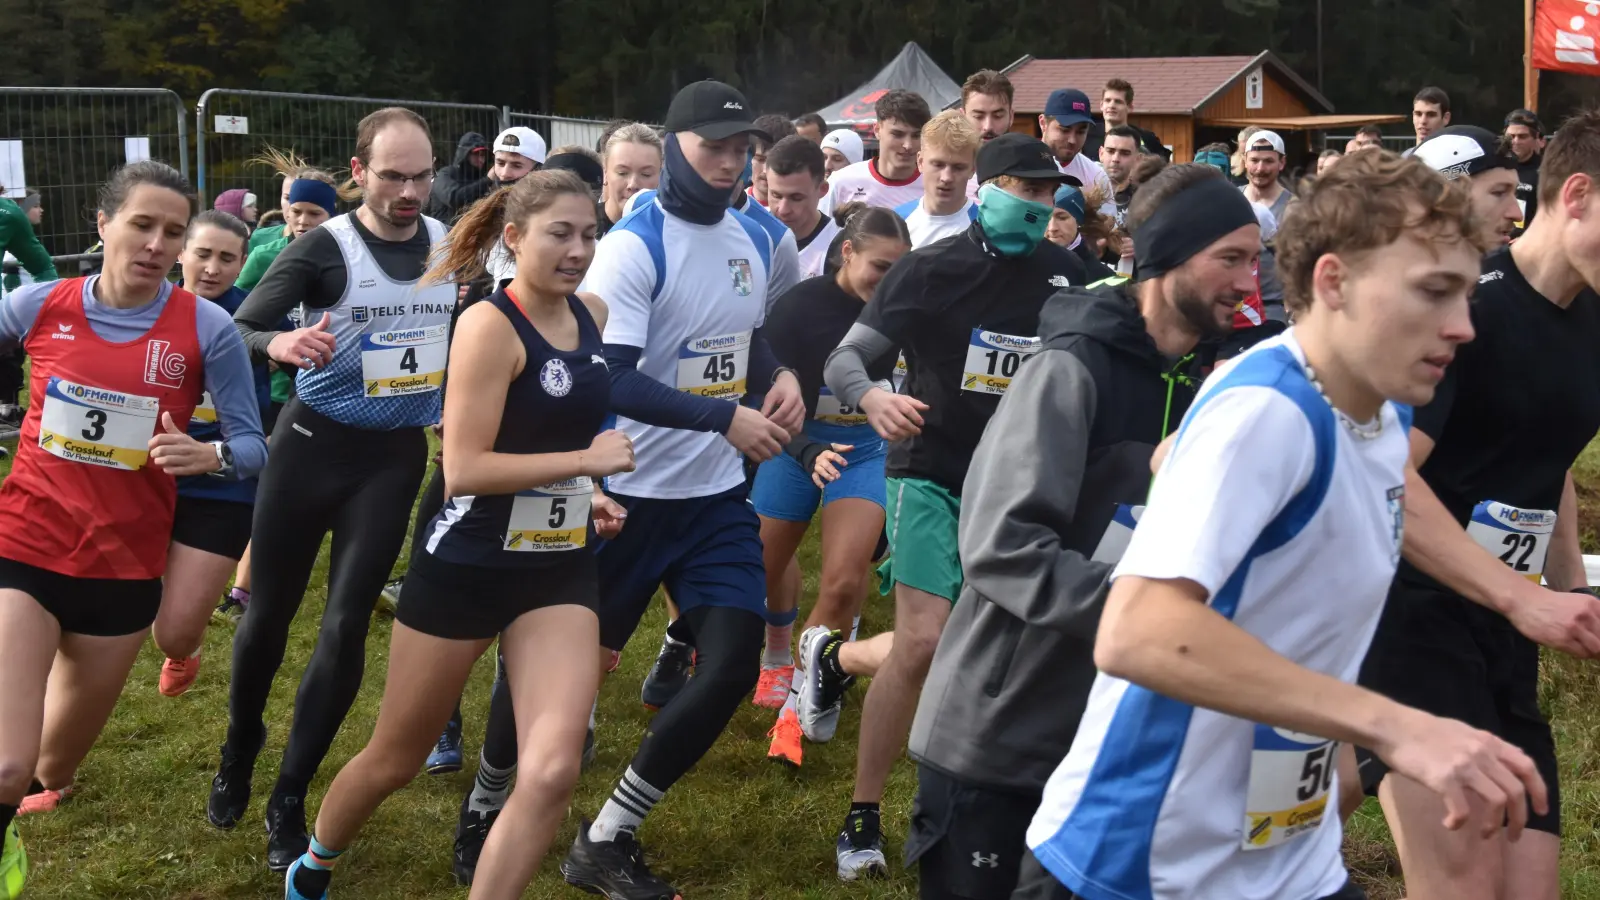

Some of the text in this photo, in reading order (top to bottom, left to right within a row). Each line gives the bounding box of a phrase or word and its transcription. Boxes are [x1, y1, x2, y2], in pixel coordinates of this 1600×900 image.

[370, 305, 405, 318] TELIS
[52, 332, 75, 341] erima
[379, 329, 425, 342] HOFMANN
[696, 336, 736, 350] HOFMANN
[988, 334, 1032, 346] HOFMANN
[148, 341, 161, 383] RÖTHENBACH
[399, 347, 419, 374] 4
[703, 353, 736, 383] 45
[985, 350, 1034, 378] 10
[389, 376, 428, 388] Crosslauf
[701, 384, 736, 397] Crosslauf
[67, 384, 126, 404] HOFMANN
[81, 409, 108, 442] 3
[62, 450, 118, 467] TSV Flachslanden
[64, 441, 115, 459] Crosslauf
[548, 497, 567, 529] 5
[1499, 507, 1545, 522] HOFMANN
[533, 531, 571, 543] Crosslauf
[1498, 533, 1537, 572] 22
